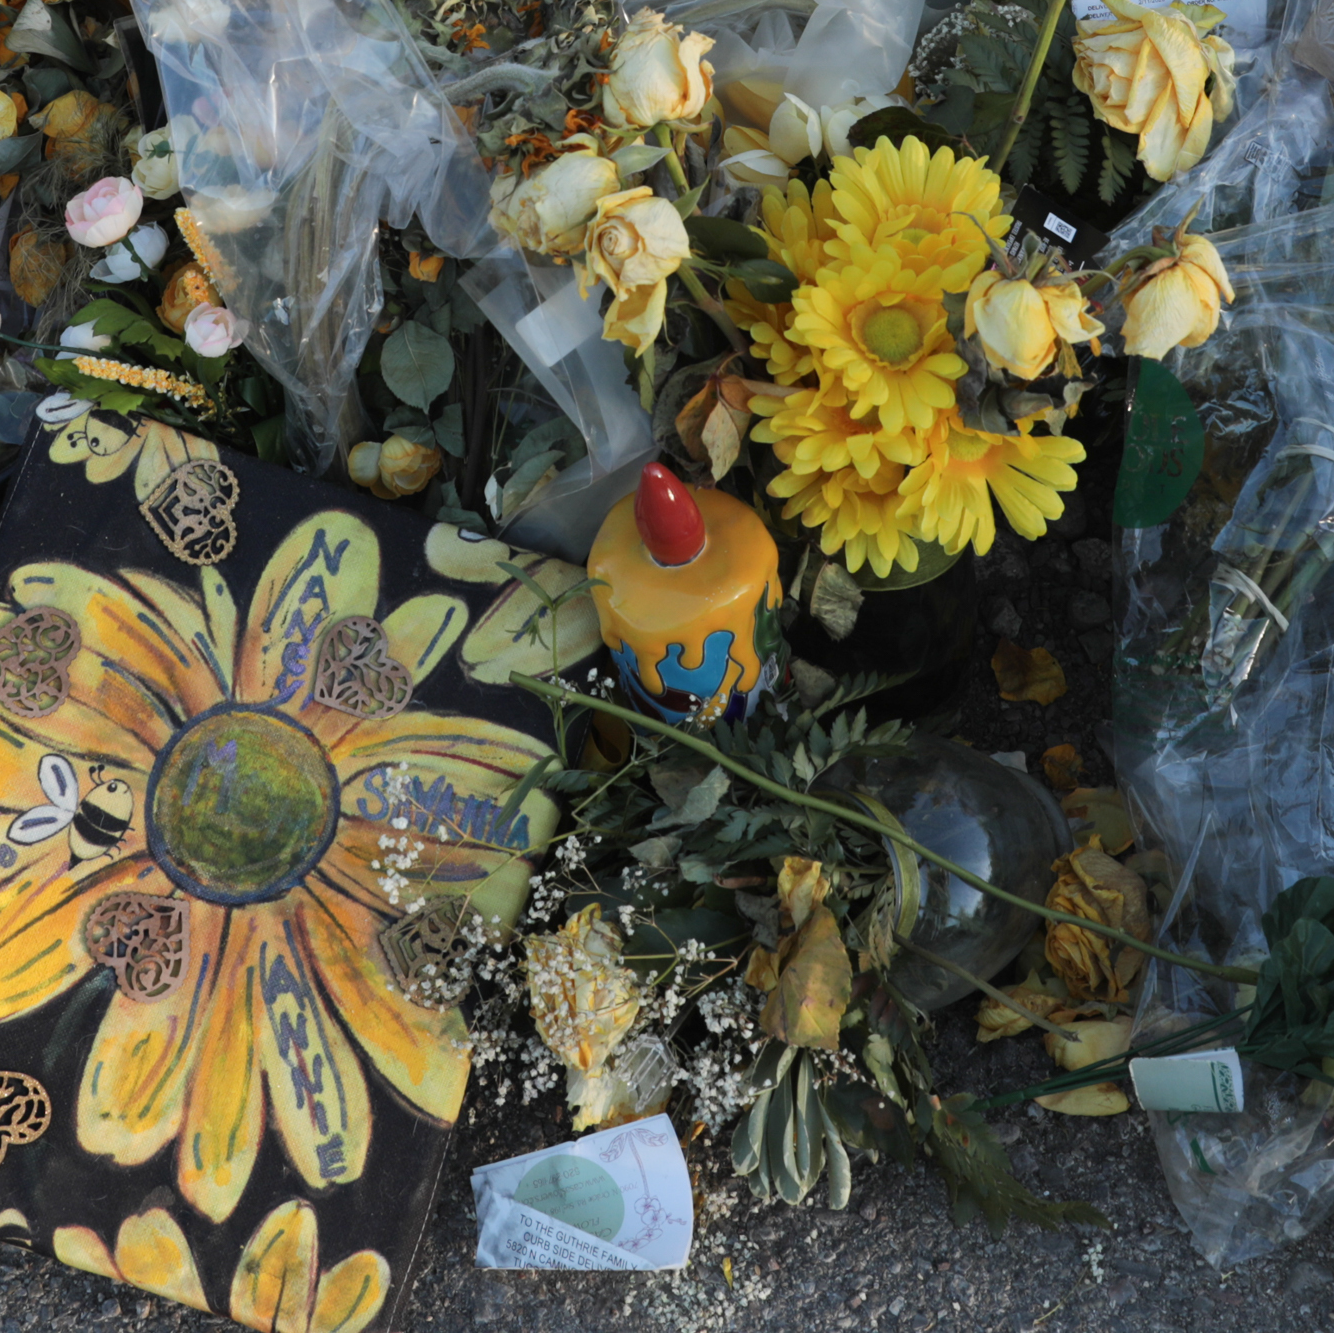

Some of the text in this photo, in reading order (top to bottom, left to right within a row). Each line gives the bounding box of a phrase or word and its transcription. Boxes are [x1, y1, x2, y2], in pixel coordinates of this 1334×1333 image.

[266, 953, 348, 1180] ANNIE
[505, 1239, 528, 1256] 5820
[529, 1249, 537, 1260] N
[520, 1213, 638, 1271] TO THE GUTHRIE FAMILY
[523, 1231, 551, 1251] CURB
[552, 1242, 576, 1262] SIDE
